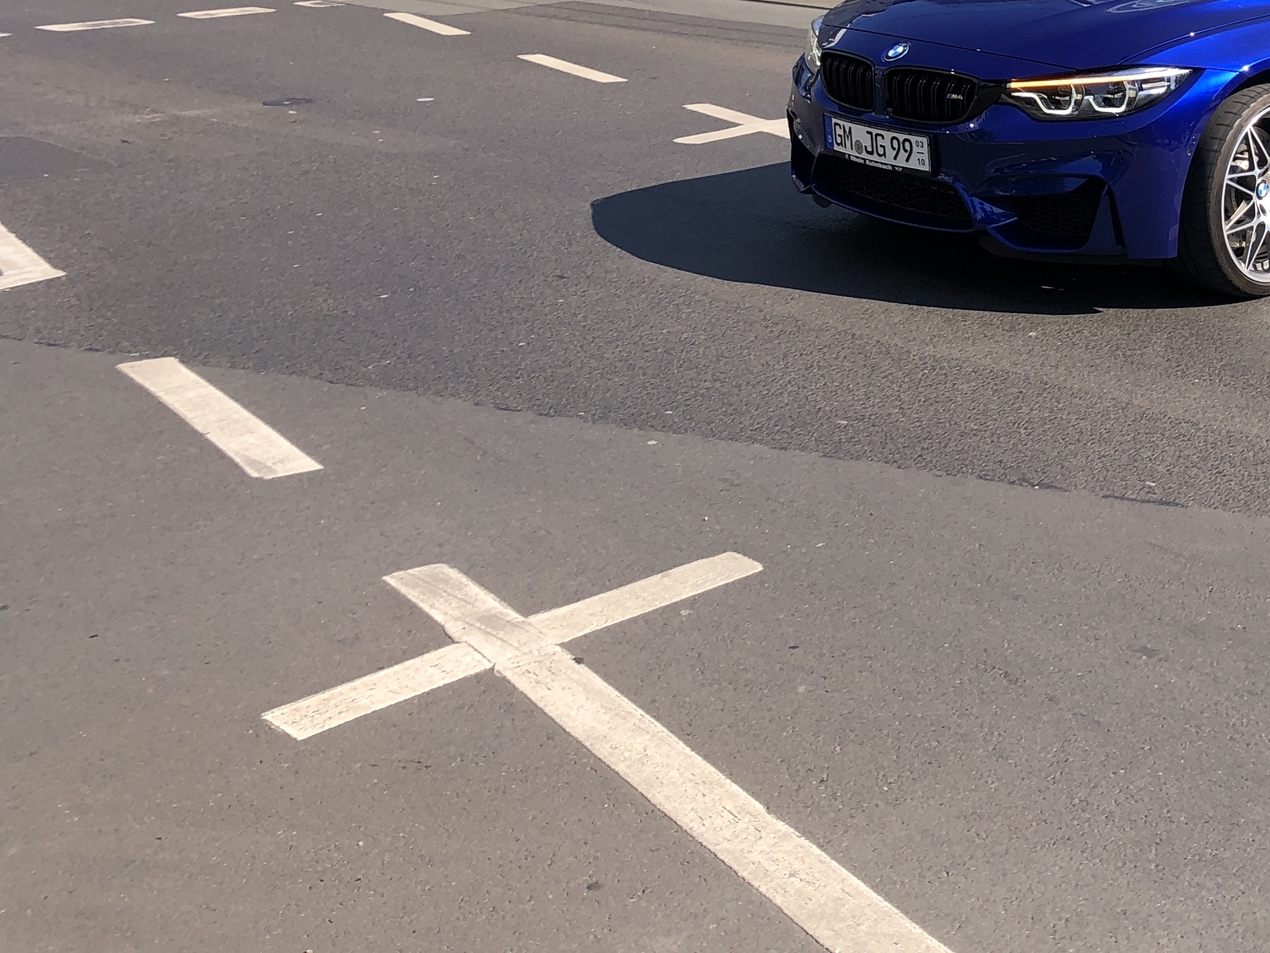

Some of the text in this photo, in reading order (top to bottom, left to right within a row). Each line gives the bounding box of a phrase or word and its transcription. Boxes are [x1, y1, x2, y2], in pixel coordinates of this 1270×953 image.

[833, 122, 914, 164] GM JG 99
[916, 157, 926, 167] 10
